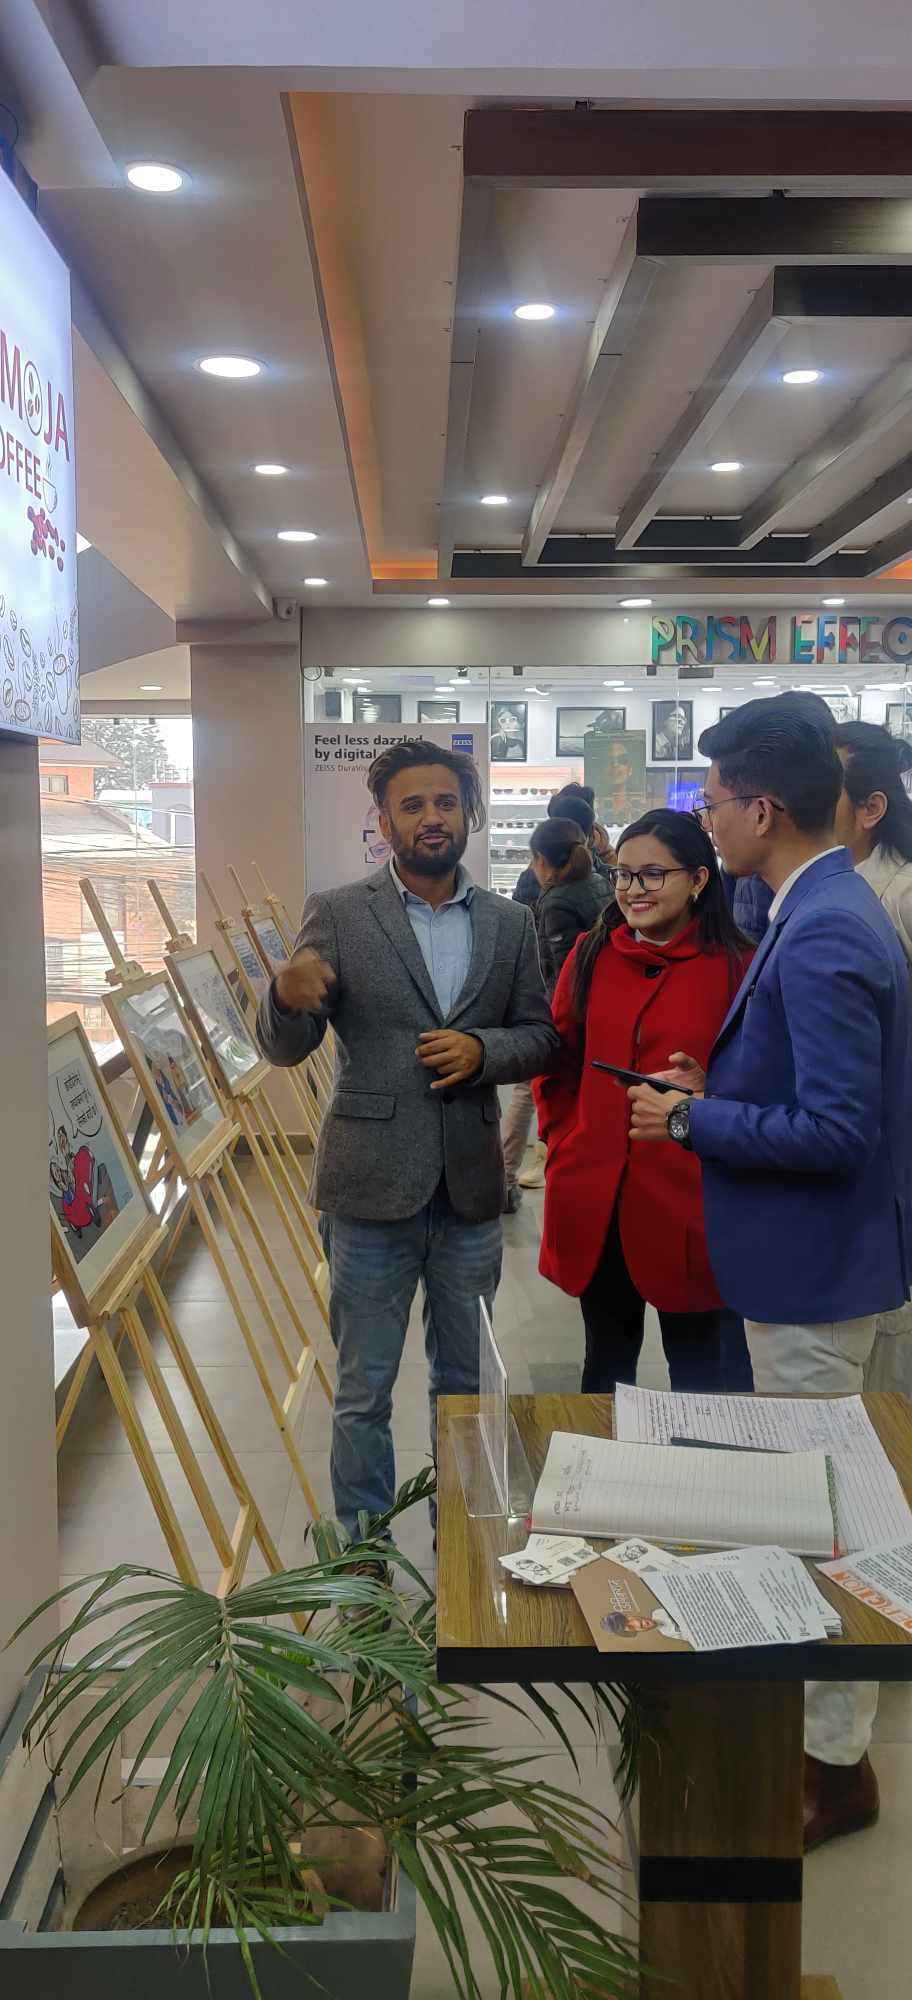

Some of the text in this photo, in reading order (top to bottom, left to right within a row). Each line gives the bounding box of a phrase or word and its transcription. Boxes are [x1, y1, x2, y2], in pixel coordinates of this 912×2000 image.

[651, 615, 777, 664] PRISM
[314, 734, 340, 745] Feel
[345, 734, 369, 745] less
[314, 748, 377, 762] by digital
